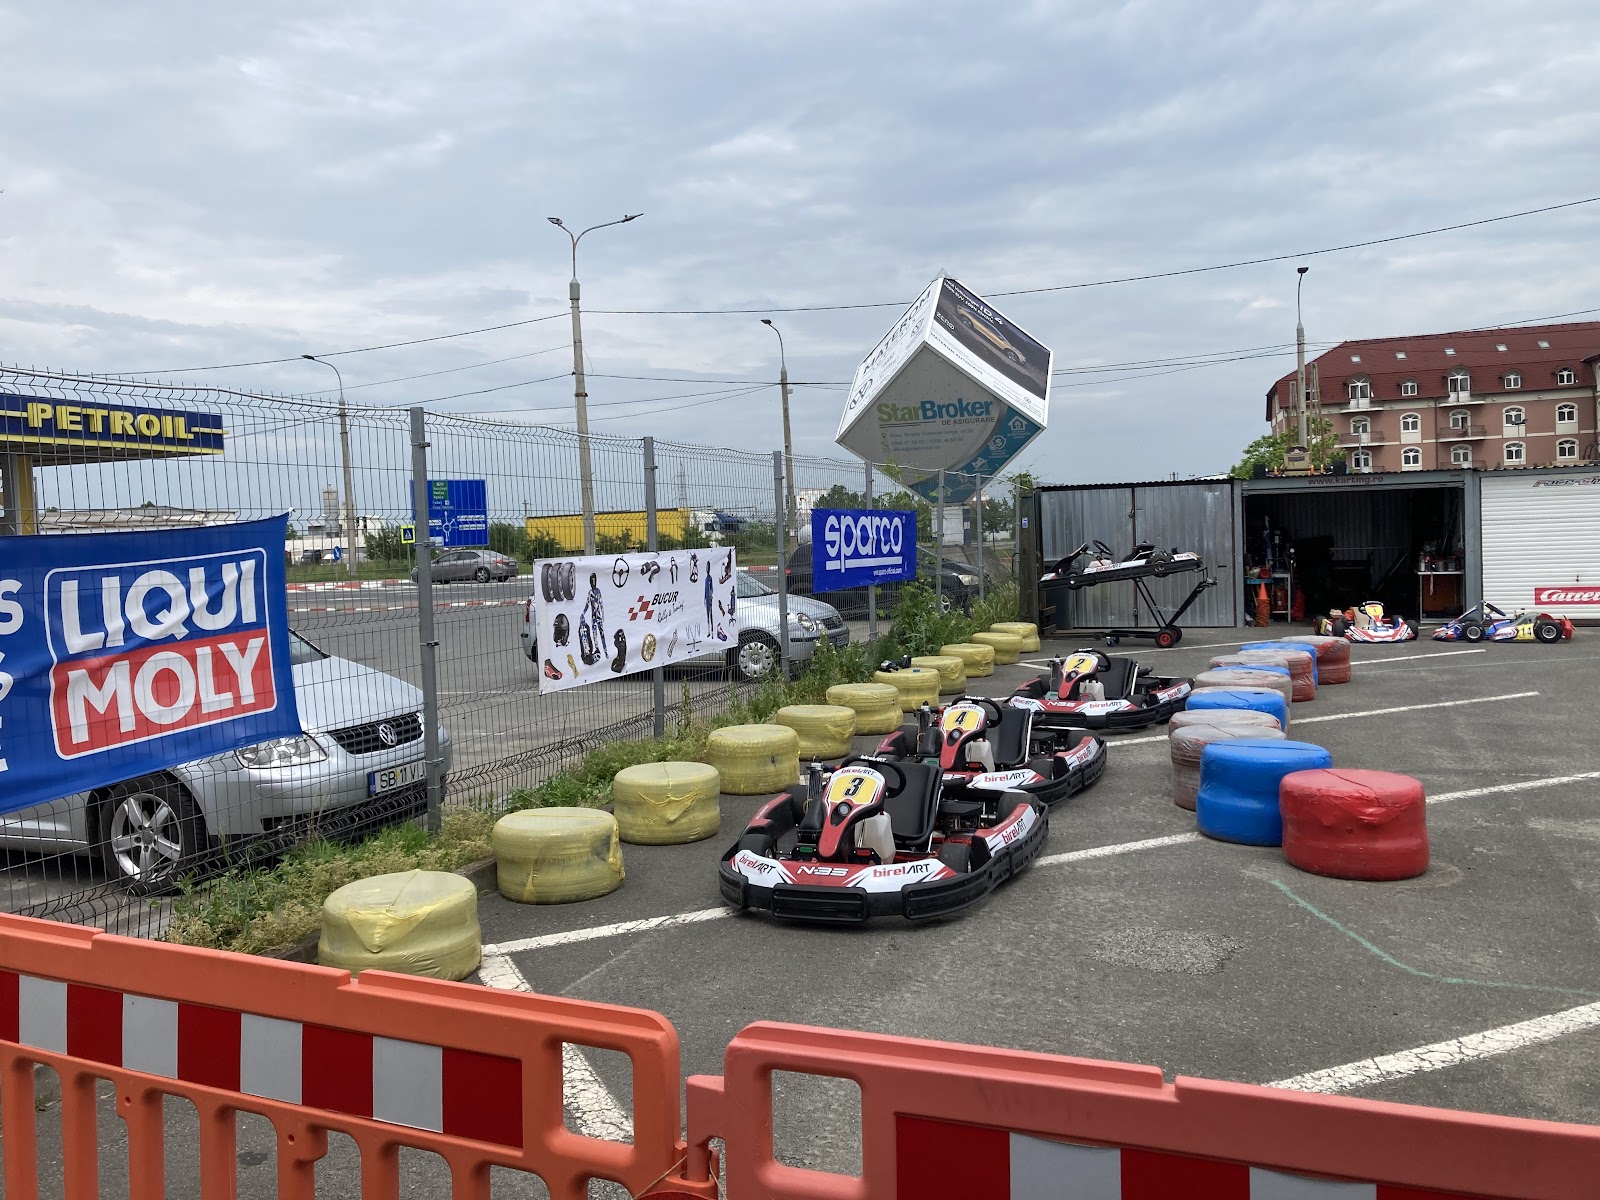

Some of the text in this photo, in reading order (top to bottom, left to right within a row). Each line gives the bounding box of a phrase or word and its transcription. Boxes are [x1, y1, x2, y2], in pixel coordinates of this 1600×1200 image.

[980, 305, 1003, 325] ID.4
[877, 398, 994, 422] StarBroker
[27, 402, 195, 440] PETROIL
[953, 416, 996, 425] ASIGURARE
[1308, 476, 1384, 485] www.karting.ro
[825, 515, 903, 573] sparco
[60, 558, 258, 655] LIQUI
[651, 591, 679, 605] BUCUR
[1073, 658, 1086, 669] 2
[67, 636, 266, 744] MOLY
[1089, 700, 1123, 709] birelART
[954, 711, 968, 725] 4
[380, 770, 396, 789] SB
[844, 777, 864, 796] 3
[984, 771, 1026, 783] birelART
[1001, 818, 1027, 844] birelART
[738, 854, 776, 874] birelART
[872, 863, 930, 878] birelART
